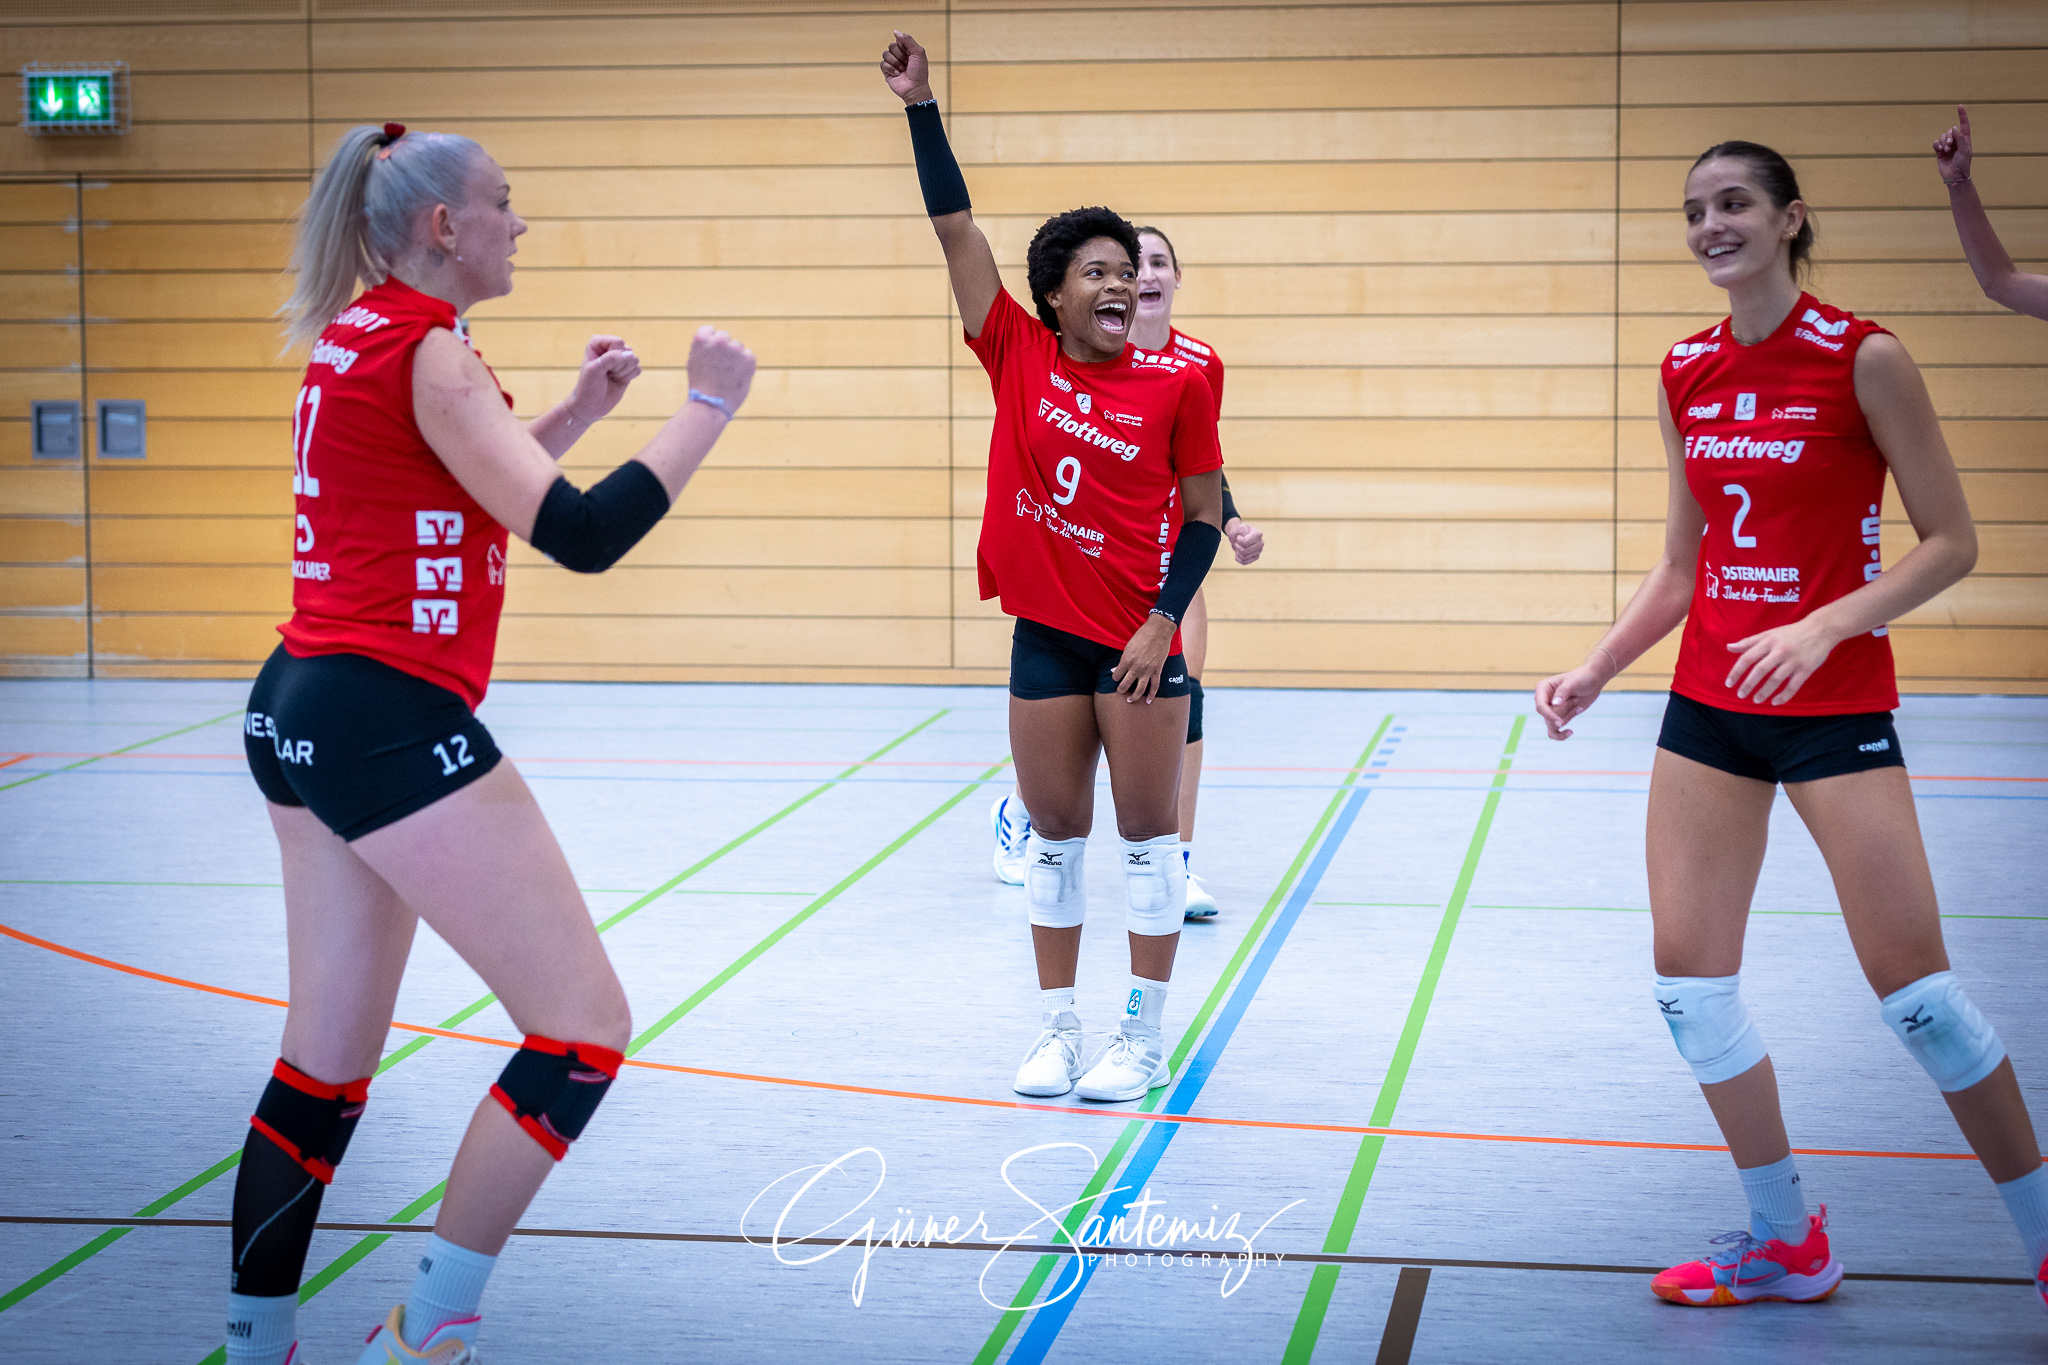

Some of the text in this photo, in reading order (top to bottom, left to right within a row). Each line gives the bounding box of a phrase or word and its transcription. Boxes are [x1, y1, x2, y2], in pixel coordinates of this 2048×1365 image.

[1045, 406, 1141, 462] Flottweg
[1692, 436, 1805, 464] Flottweg
[1053, 456, 1082, 506] 9
[1723, 484, 1757, 548] 2
[1721, 565, 1800, 582] OSTERMAIER
[432, 733, 475, 777] 12
